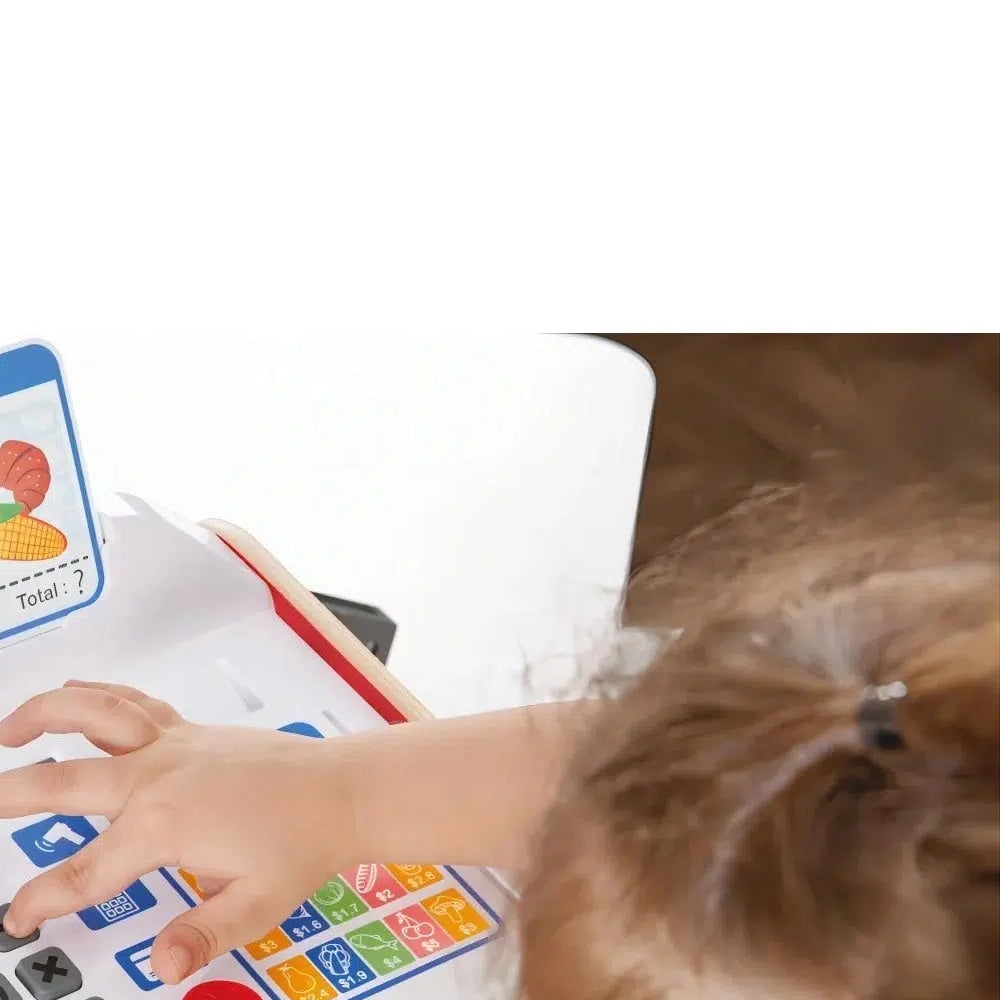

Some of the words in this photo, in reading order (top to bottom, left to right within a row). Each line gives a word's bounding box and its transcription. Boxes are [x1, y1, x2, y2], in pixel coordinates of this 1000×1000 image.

[16, 582, 58, 610] Total
[260, 940, 278, 953] $3
[293, 920, 322, 938] $1.6
[332, 903, 359, 920] $1.7
[376, 889, 394, 902] $2
[338, 970, 367, 988] $1.9
